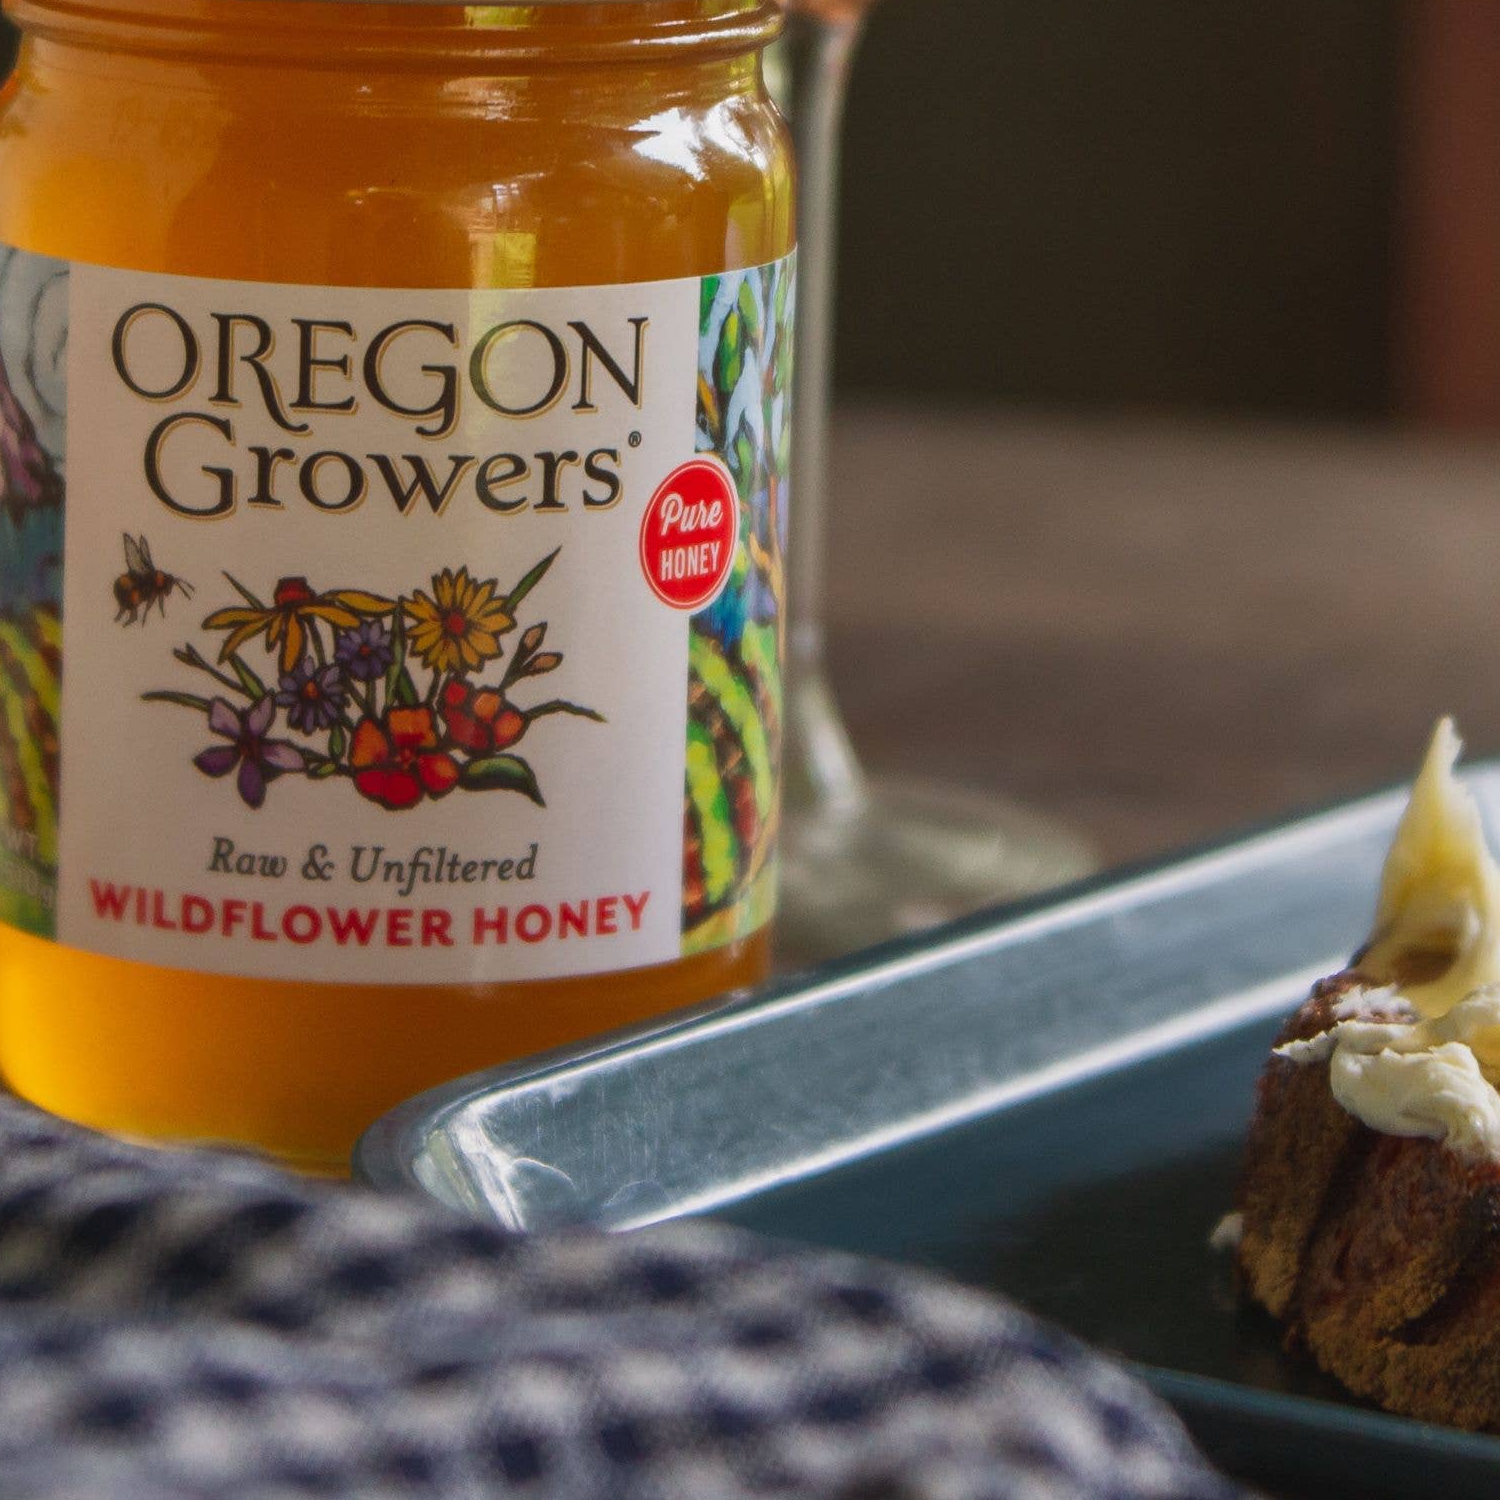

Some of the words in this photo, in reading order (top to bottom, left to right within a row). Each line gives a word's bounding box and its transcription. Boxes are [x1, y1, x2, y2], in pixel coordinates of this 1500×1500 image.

[111, 302, 650, 438] OREGON
[660, 493, 724, 536] Pure
[661, 541, 720, 581] HONEY
[208, 836, 289, 878] Raw
[301, 846, 335, 879] &
[352, 843, 540, 895] Unfiltered
[89, 878, 456, 947] WILDFLOWER
[472, 891, 651, 946] HONEY
